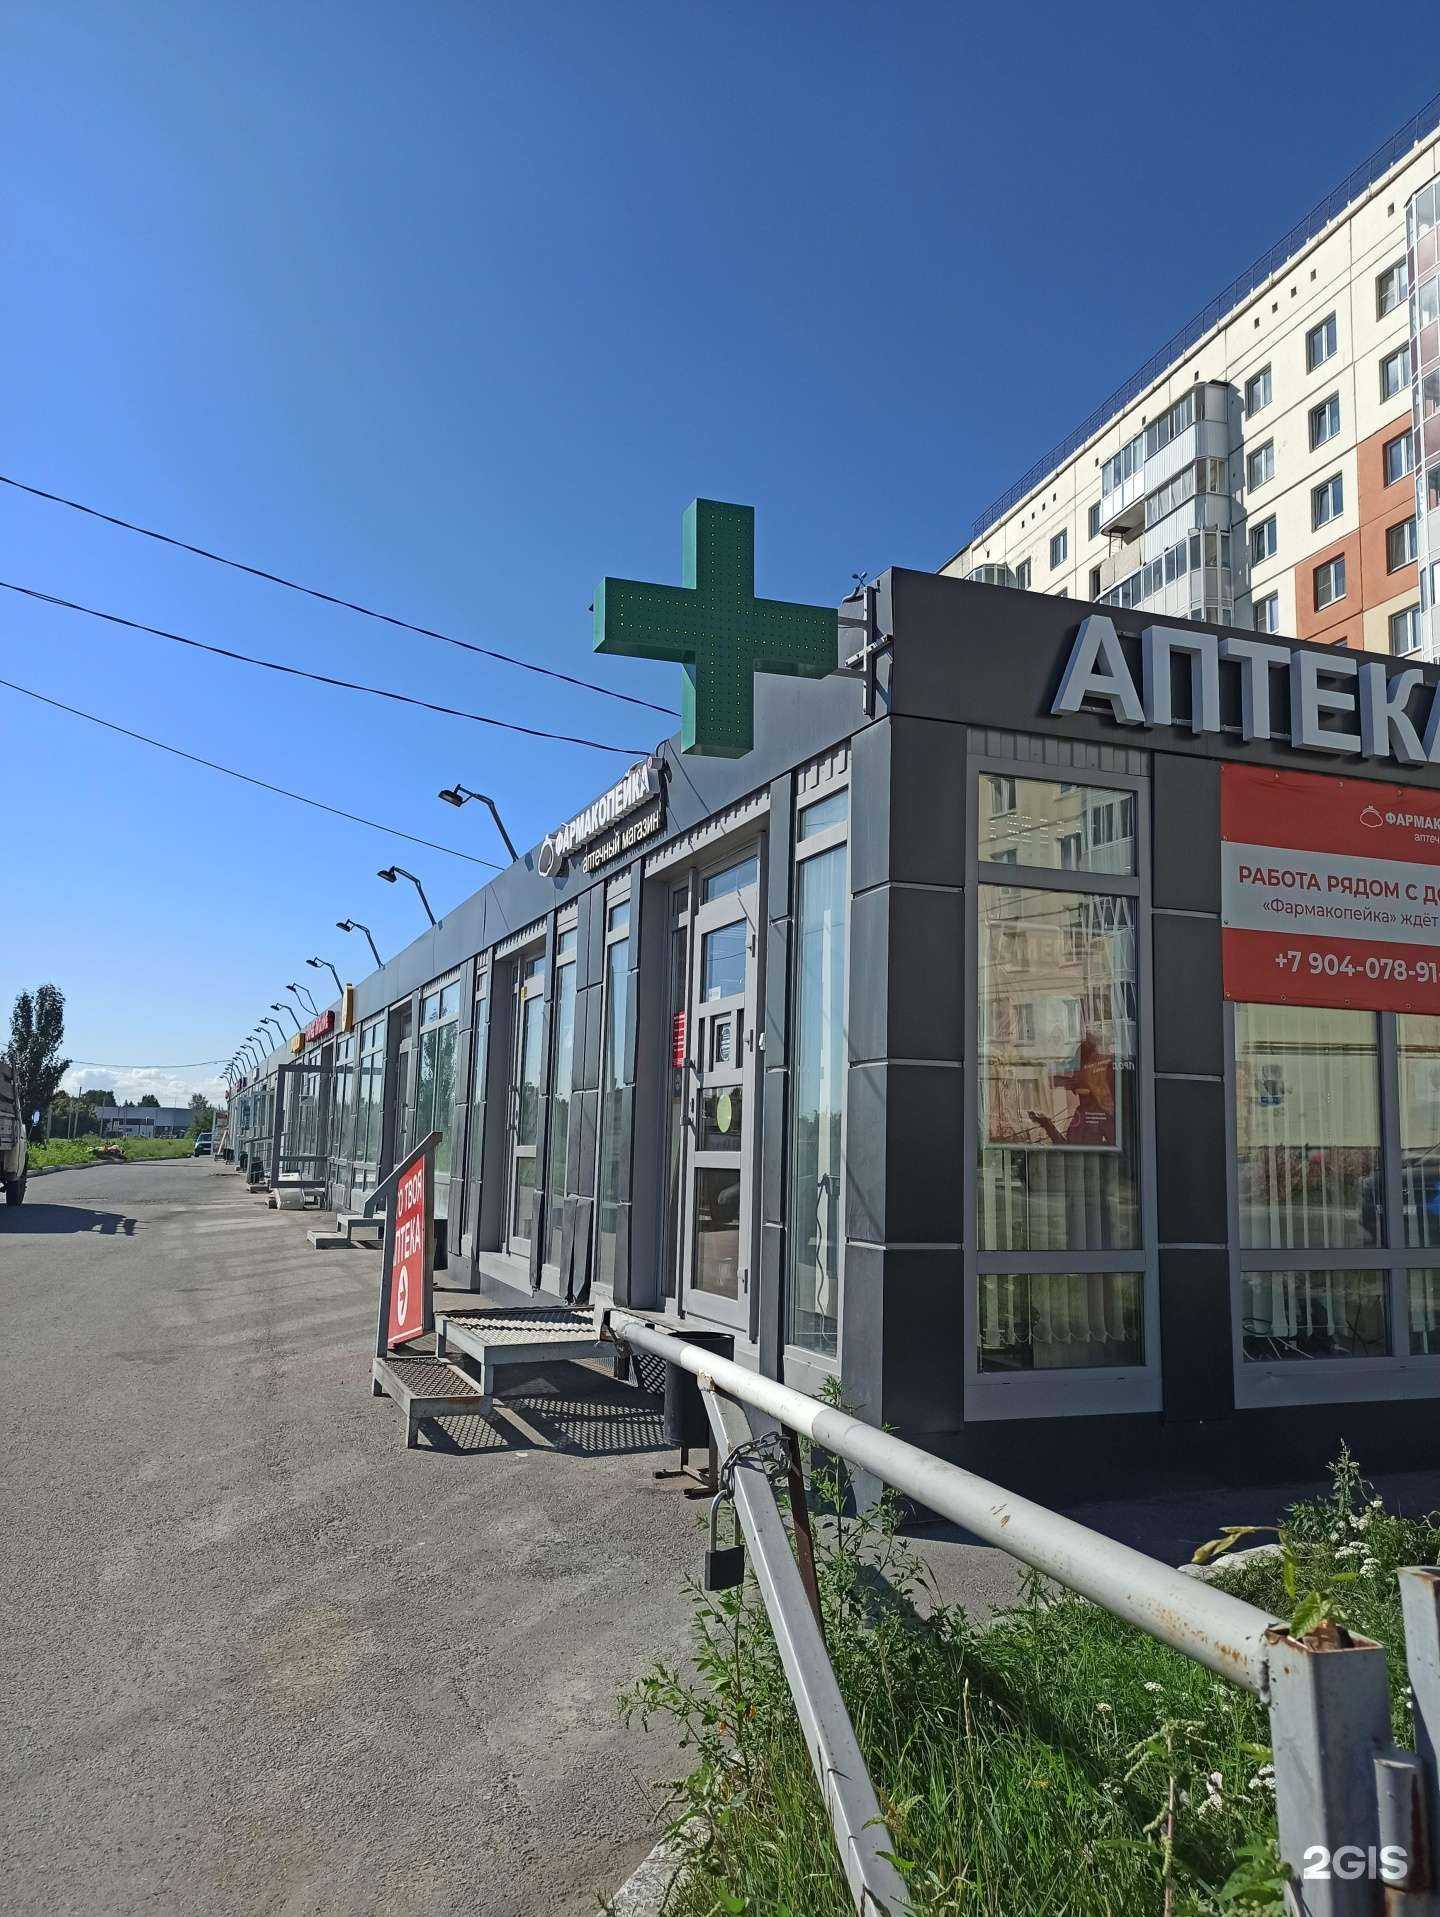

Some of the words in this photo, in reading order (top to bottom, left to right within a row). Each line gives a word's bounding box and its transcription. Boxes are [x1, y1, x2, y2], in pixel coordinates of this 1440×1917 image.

[1050, 613, 1440, 765] АПТЕК
[555, 763, 650, 857] ФАРМАКОПЕЙКА
[582, 829, 621, 874] аптечный
[621, 808, 660, 850] магазин
[1238, 864, 1322, 892] РАБОТА
[1327, 875, 1400, 899] РЯДОМ
[1405, 883, 1418, 901] С
[1423, 885, 1440, 906] Д
[1263, 898, 1397, 923] «Фармакопейка»
[1400, 911, 1440, 928] ждёт
[1275, 950, 1302, 973] +7
[1308, 952, 1440, 984] 904-078-91
[405, 1168, 422, 1213] ТВОЯ
[393, 1213, 422, 1266] ПТЕКА
